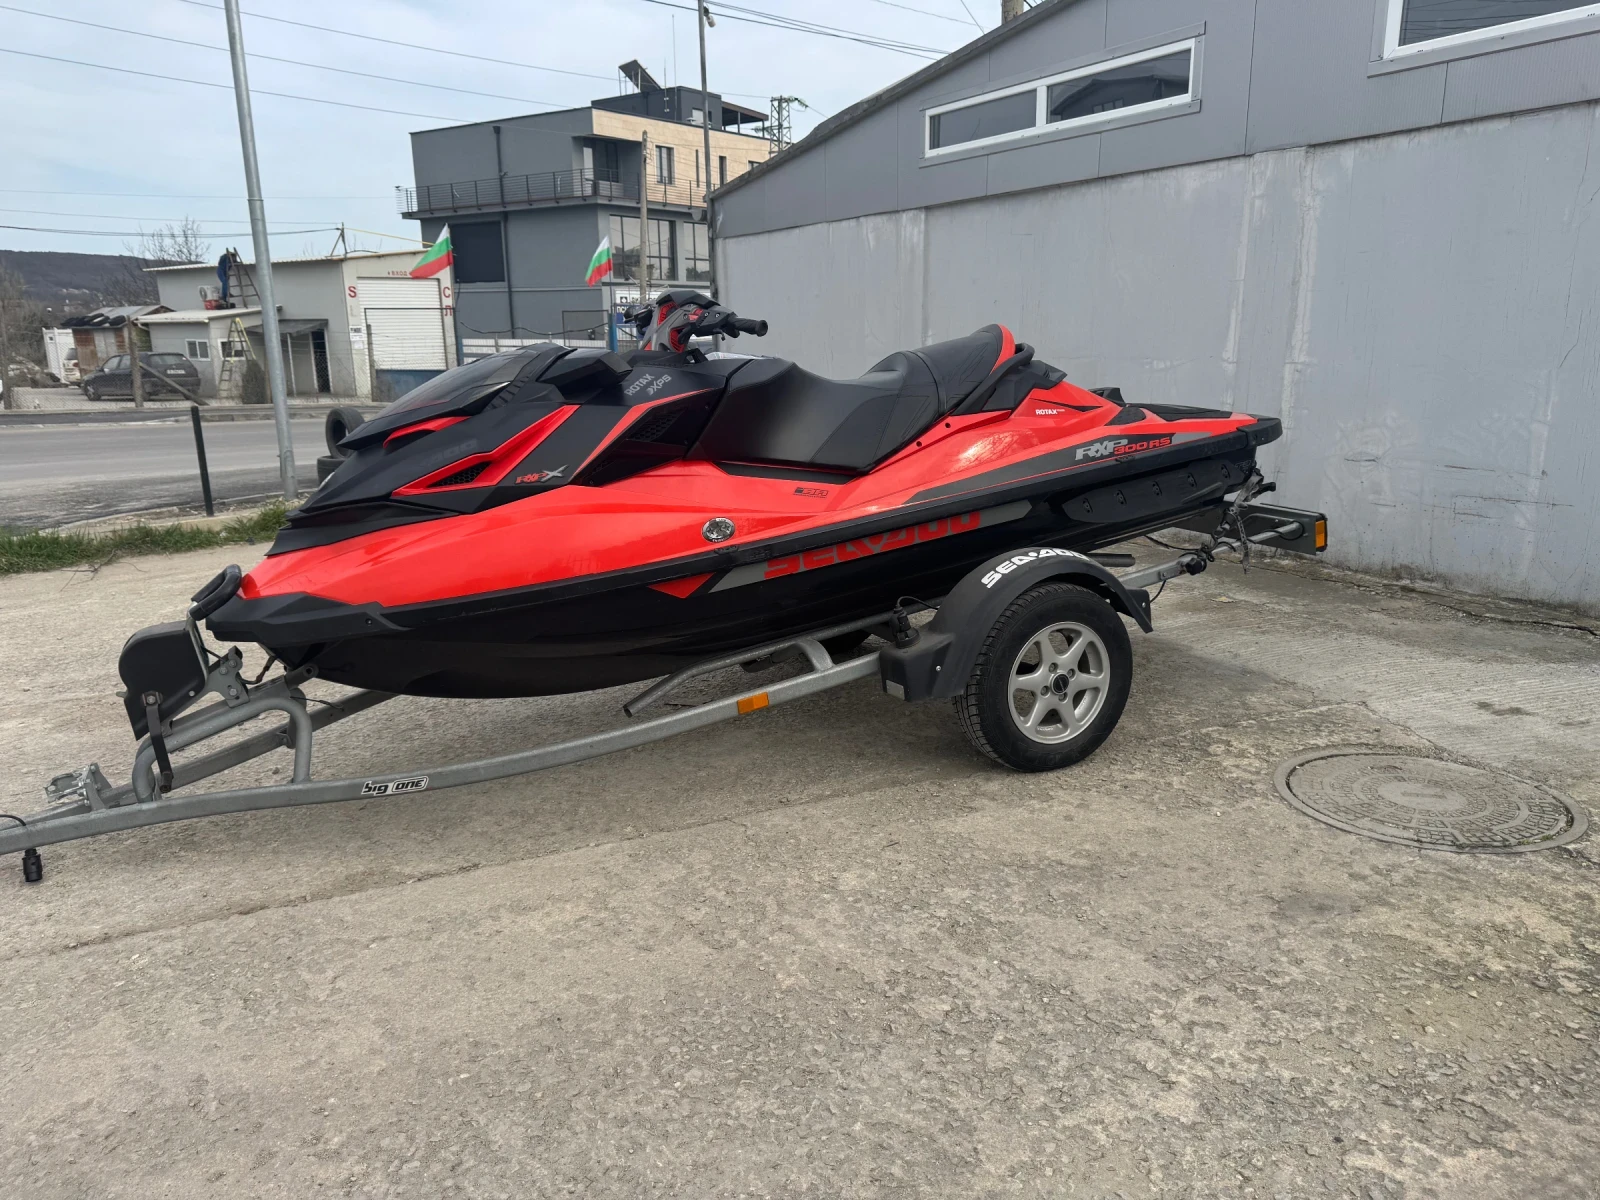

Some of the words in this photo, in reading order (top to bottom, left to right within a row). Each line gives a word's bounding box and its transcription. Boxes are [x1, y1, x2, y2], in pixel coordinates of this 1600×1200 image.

[624, 373, 655, 396] ROTAX
[1035, 408, 1058, 416] ROTAX
[1074, 438, 1129, 461] RXP
[1114, 441, 1148, 455] 300
[1149, 437, 1171, 449] RS
